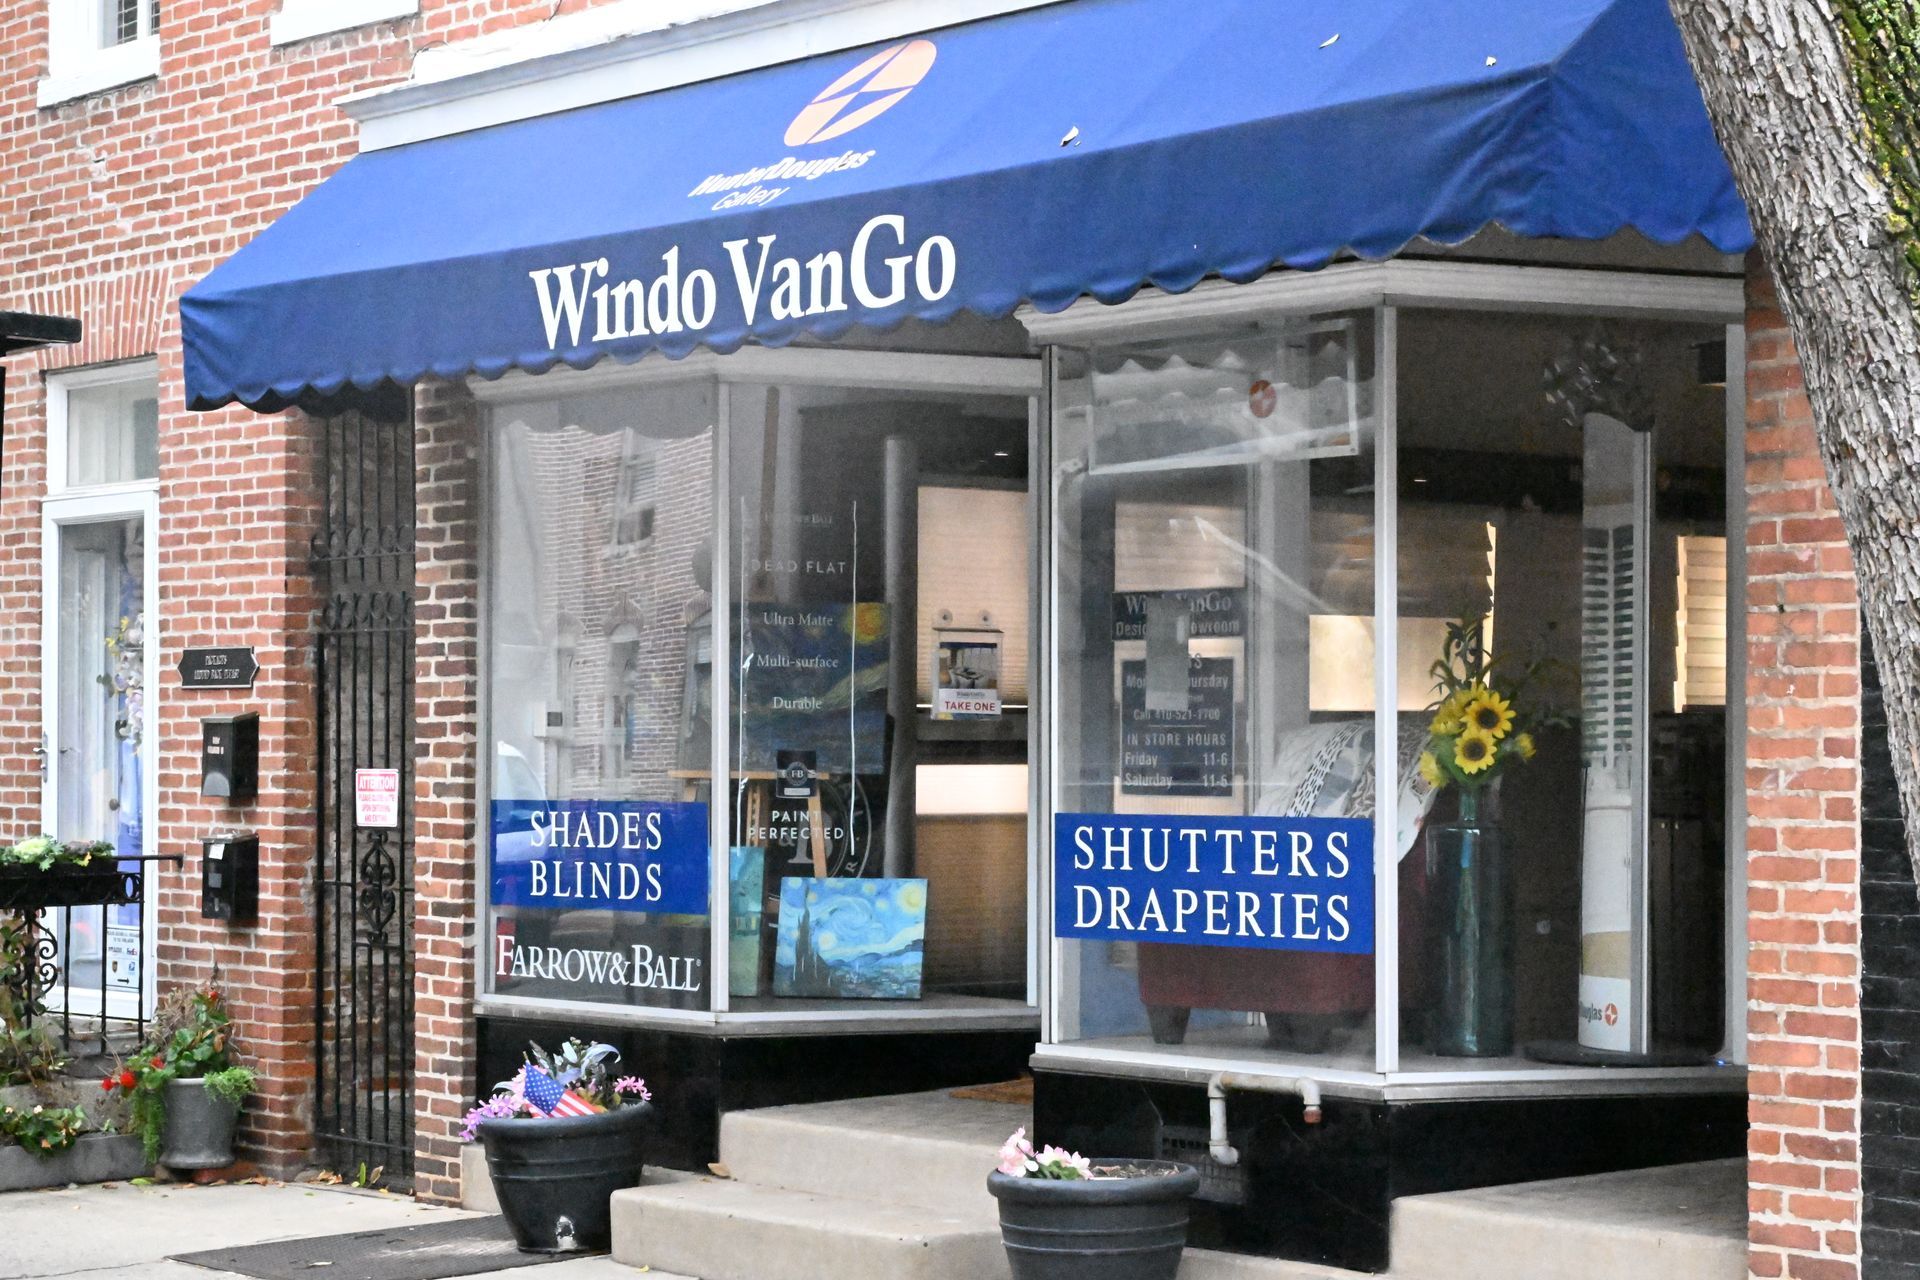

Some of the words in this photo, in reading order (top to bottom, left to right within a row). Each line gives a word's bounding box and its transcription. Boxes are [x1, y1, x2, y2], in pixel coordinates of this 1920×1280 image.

[688, 150, 876, 198] HunterDouglas
[712, 185, 790, 211] Gallery
[529, 245, 716, 350] Windo
[722, 214, 956, 326] VanGo
[751, 559, 798, 573] DEAD
[806, 561, 846, 573] FLAT
[763, 612, 795, 625] Ultra
[799, 613, 834, 626] Matte
[757, 654, 839, 668] Multi-surface
[773, 696, 823, 711] Durable
[945, 701, 971, 711] TAKE
[974, 702, 996, 712] ONE
[1127, 733, 1138, 746] IN
[1145, 733, 1180, 746] STORE
[1187, 733, 1226, 746] HOURS
[1125, 752, 1158, 768] Friday
[1203, 752, 1228, 766] 11-6
[1125, 772, 1173, 789] Saturday
[772, 810, 820, 822] PAINT
[530, 810, 662, 850] SHADES
[749, 827, 844, 840] PERFECTED
[1074, 826, 1349, 878] SHUTTERS
[530, 860, 662, 901] BLINDS
[1074, 885, 1349, 942] DRAPERIES
